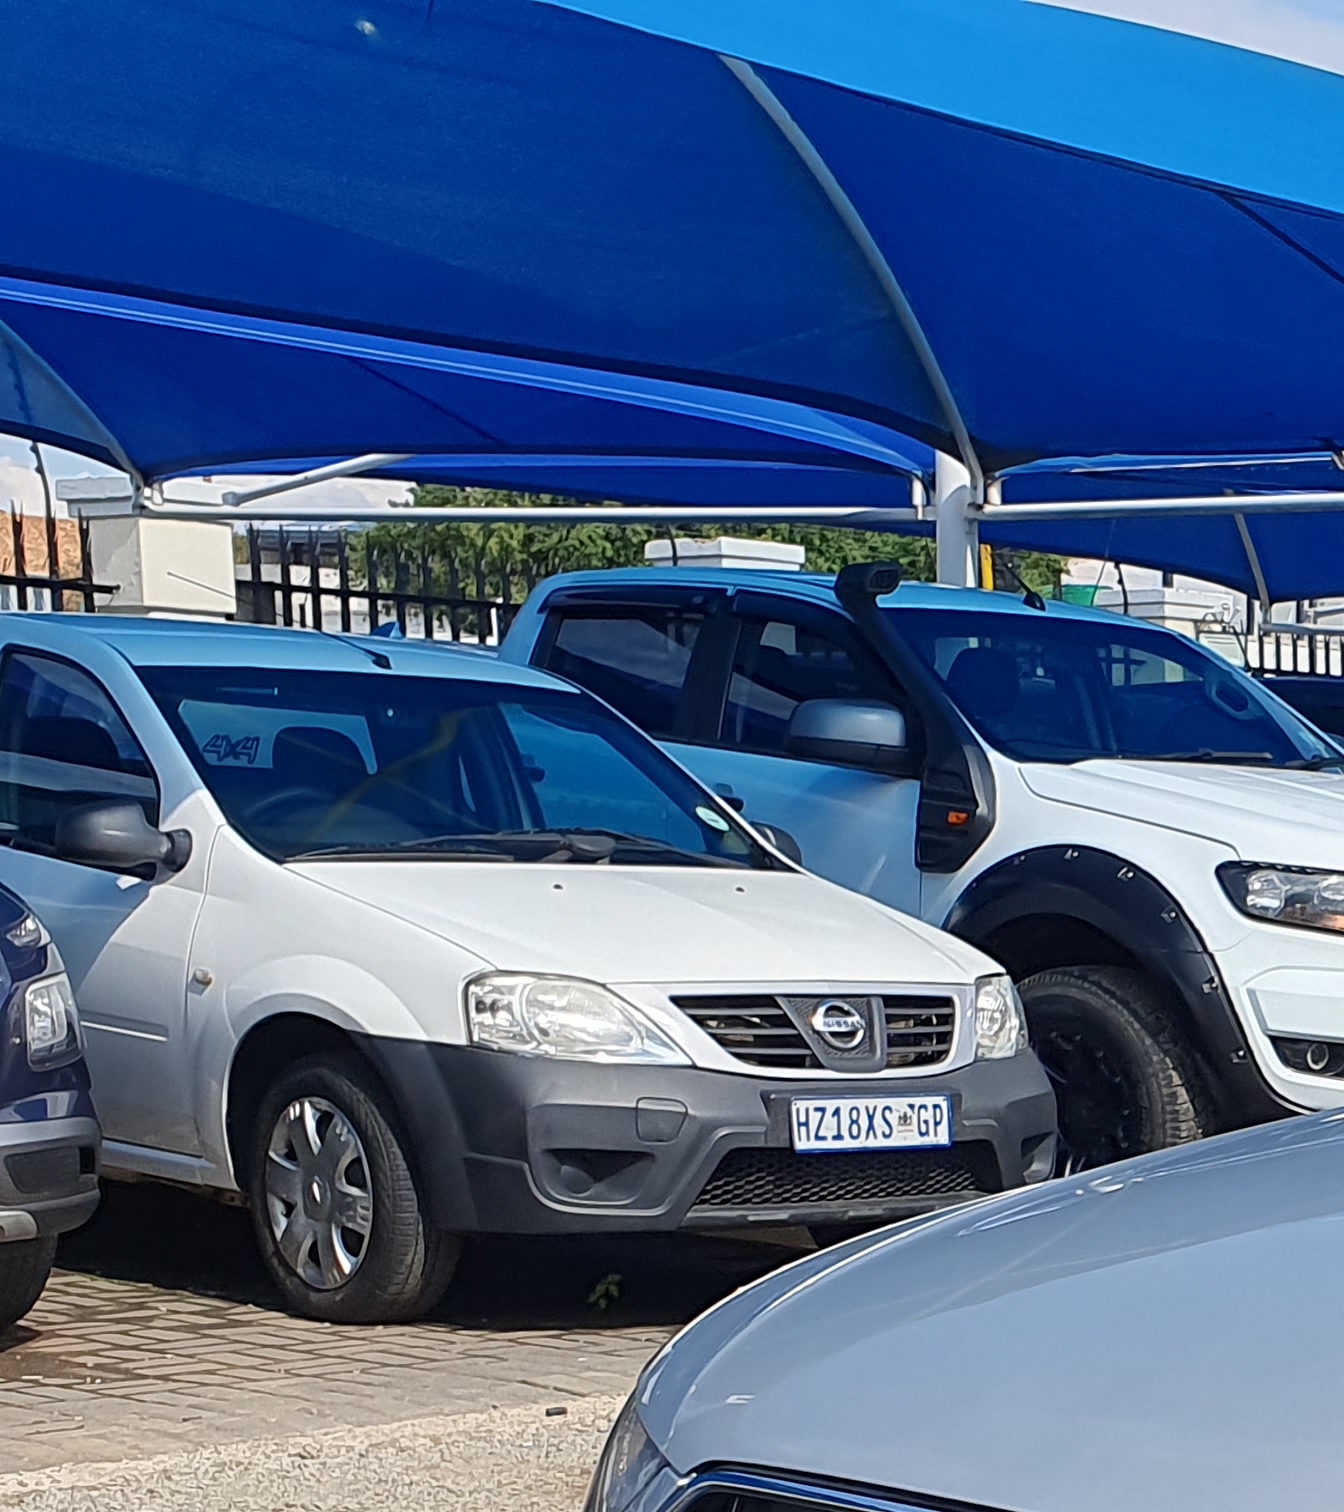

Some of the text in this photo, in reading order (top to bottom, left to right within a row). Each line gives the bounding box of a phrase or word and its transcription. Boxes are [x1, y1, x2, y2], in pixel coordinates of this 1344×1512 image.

[822, 1016, 867, 1030] NISSAN
[796, 1103, 944, 1143] HZ18XS GP
